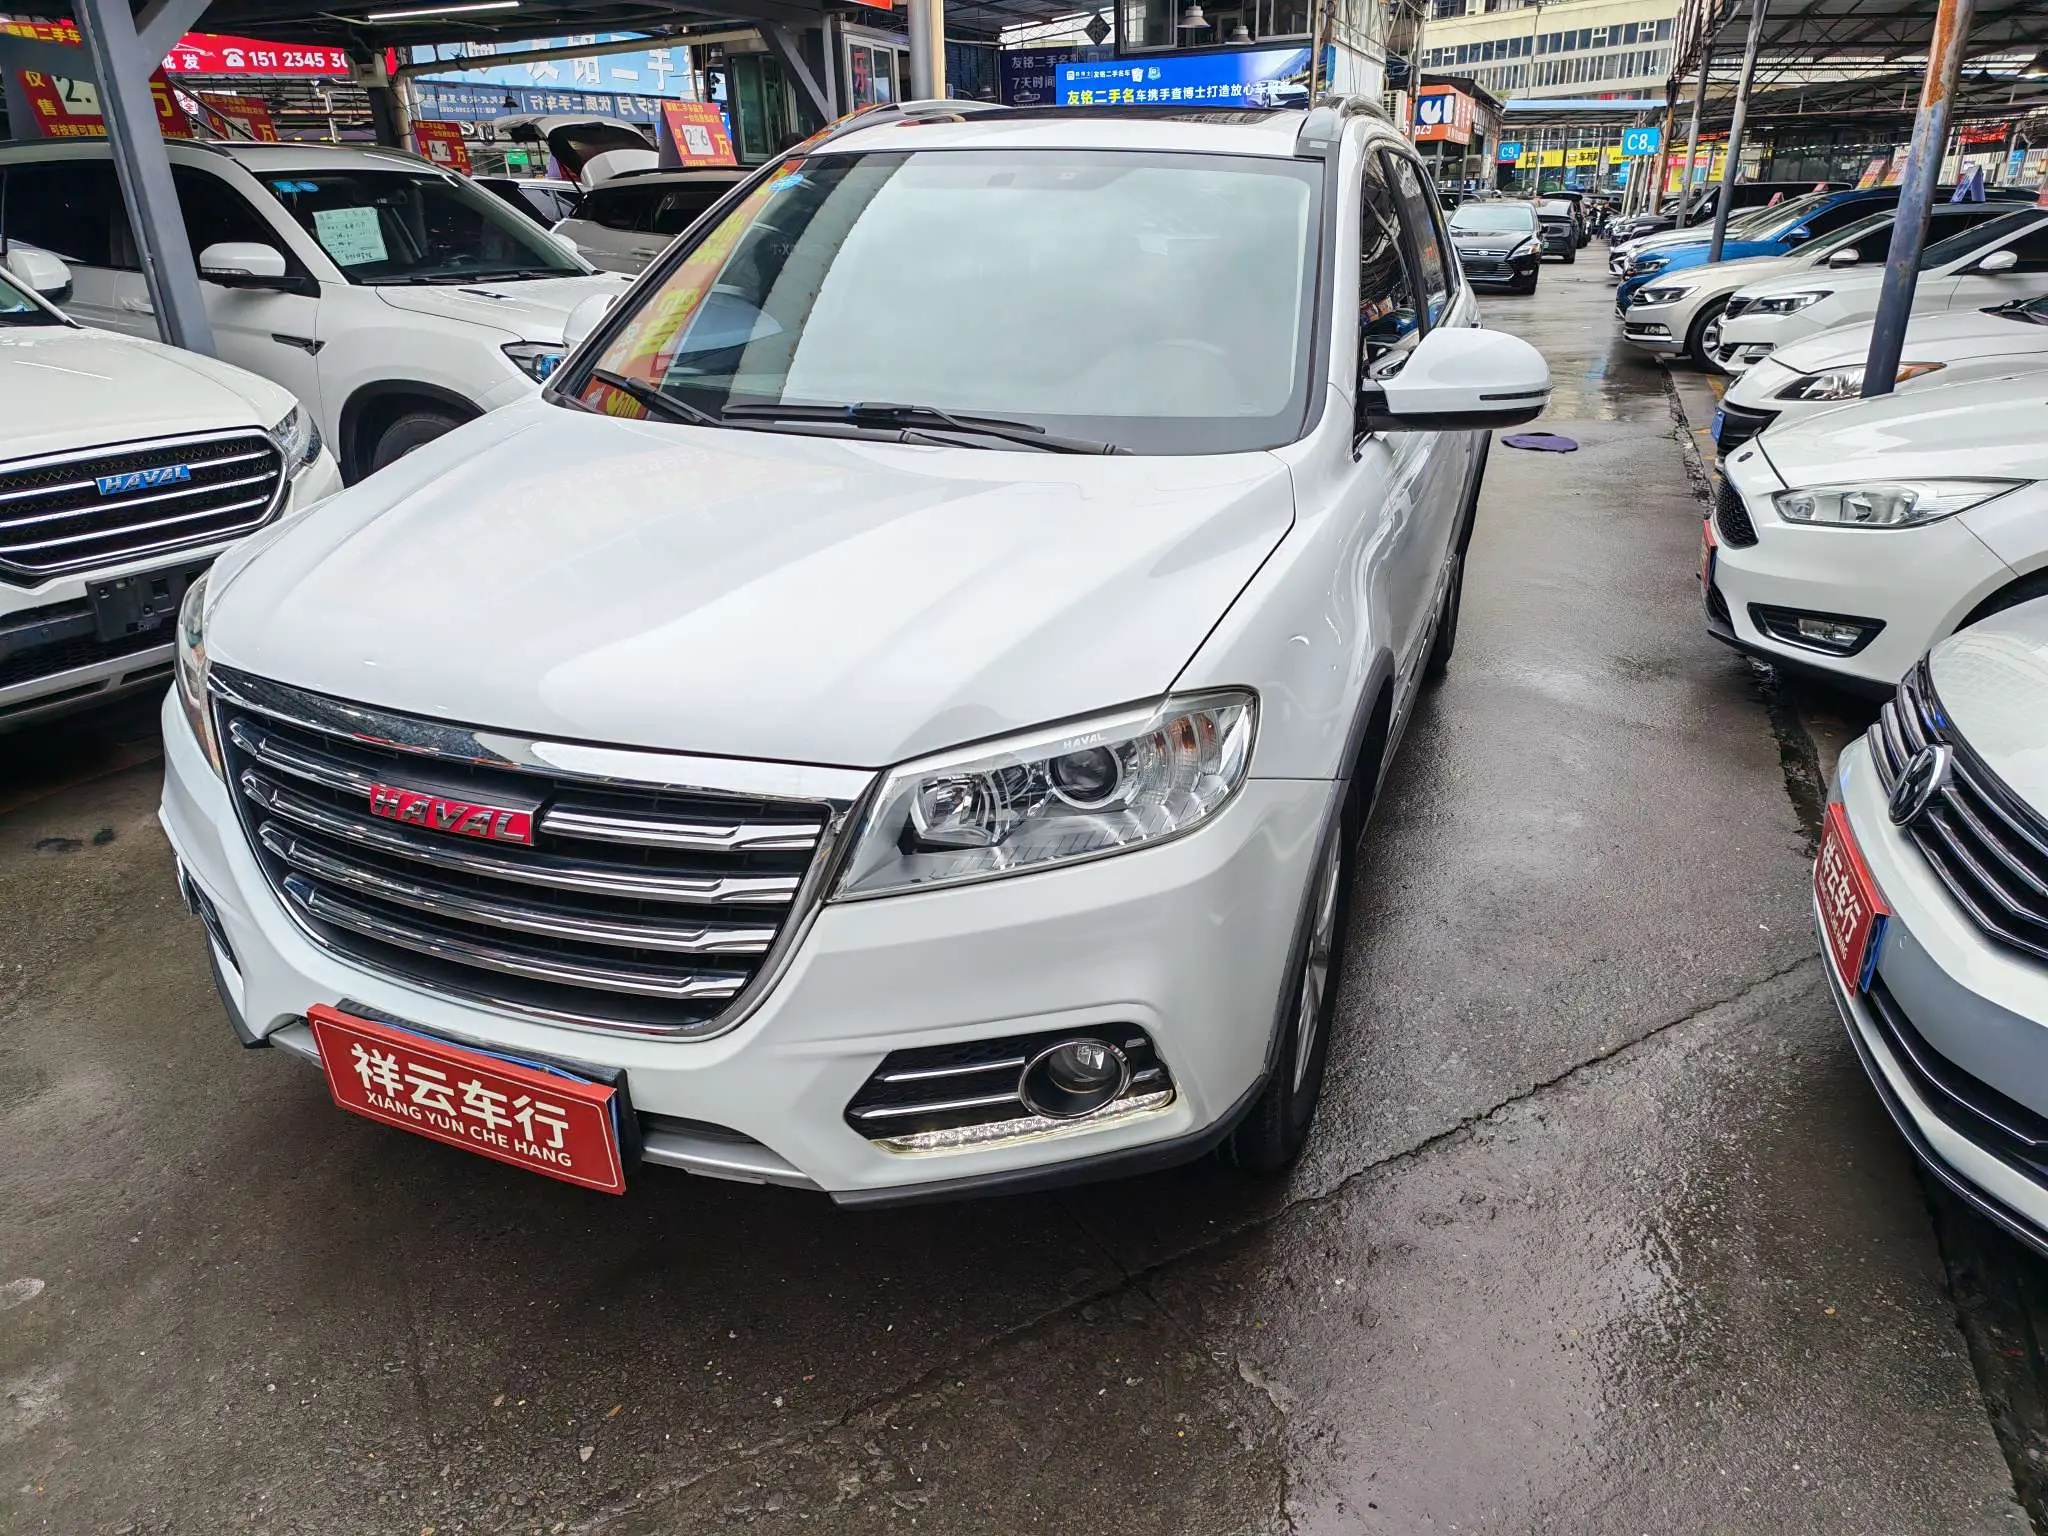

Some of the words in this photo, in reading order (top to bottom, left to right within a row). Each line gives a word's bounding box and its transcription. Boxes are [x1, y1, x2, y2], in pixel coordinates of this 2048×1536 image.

[249, 51, 278, 67] 151
[284, 51, 325, 68] 2345
[454, 145, 466, 162] 万
[714, 133, 730, 156] 万
[1501, 146, 1514, 158] C9
[1627, 133, 1648, 153] C8
[104, 465, 190, 490] HAVAL
[1063, 733, 1107, 749] HAVAL
[373, 789, 526, 842] HAVAL
[351, 1042, 570, 1149] 祥云车行
[366, 1090, 422, 1121] XIANG
[425, 1113, 466, 1135] YUN
[470, 1124, 509, 1148] CHE
[514, 1139, 573, 1168] HANG
